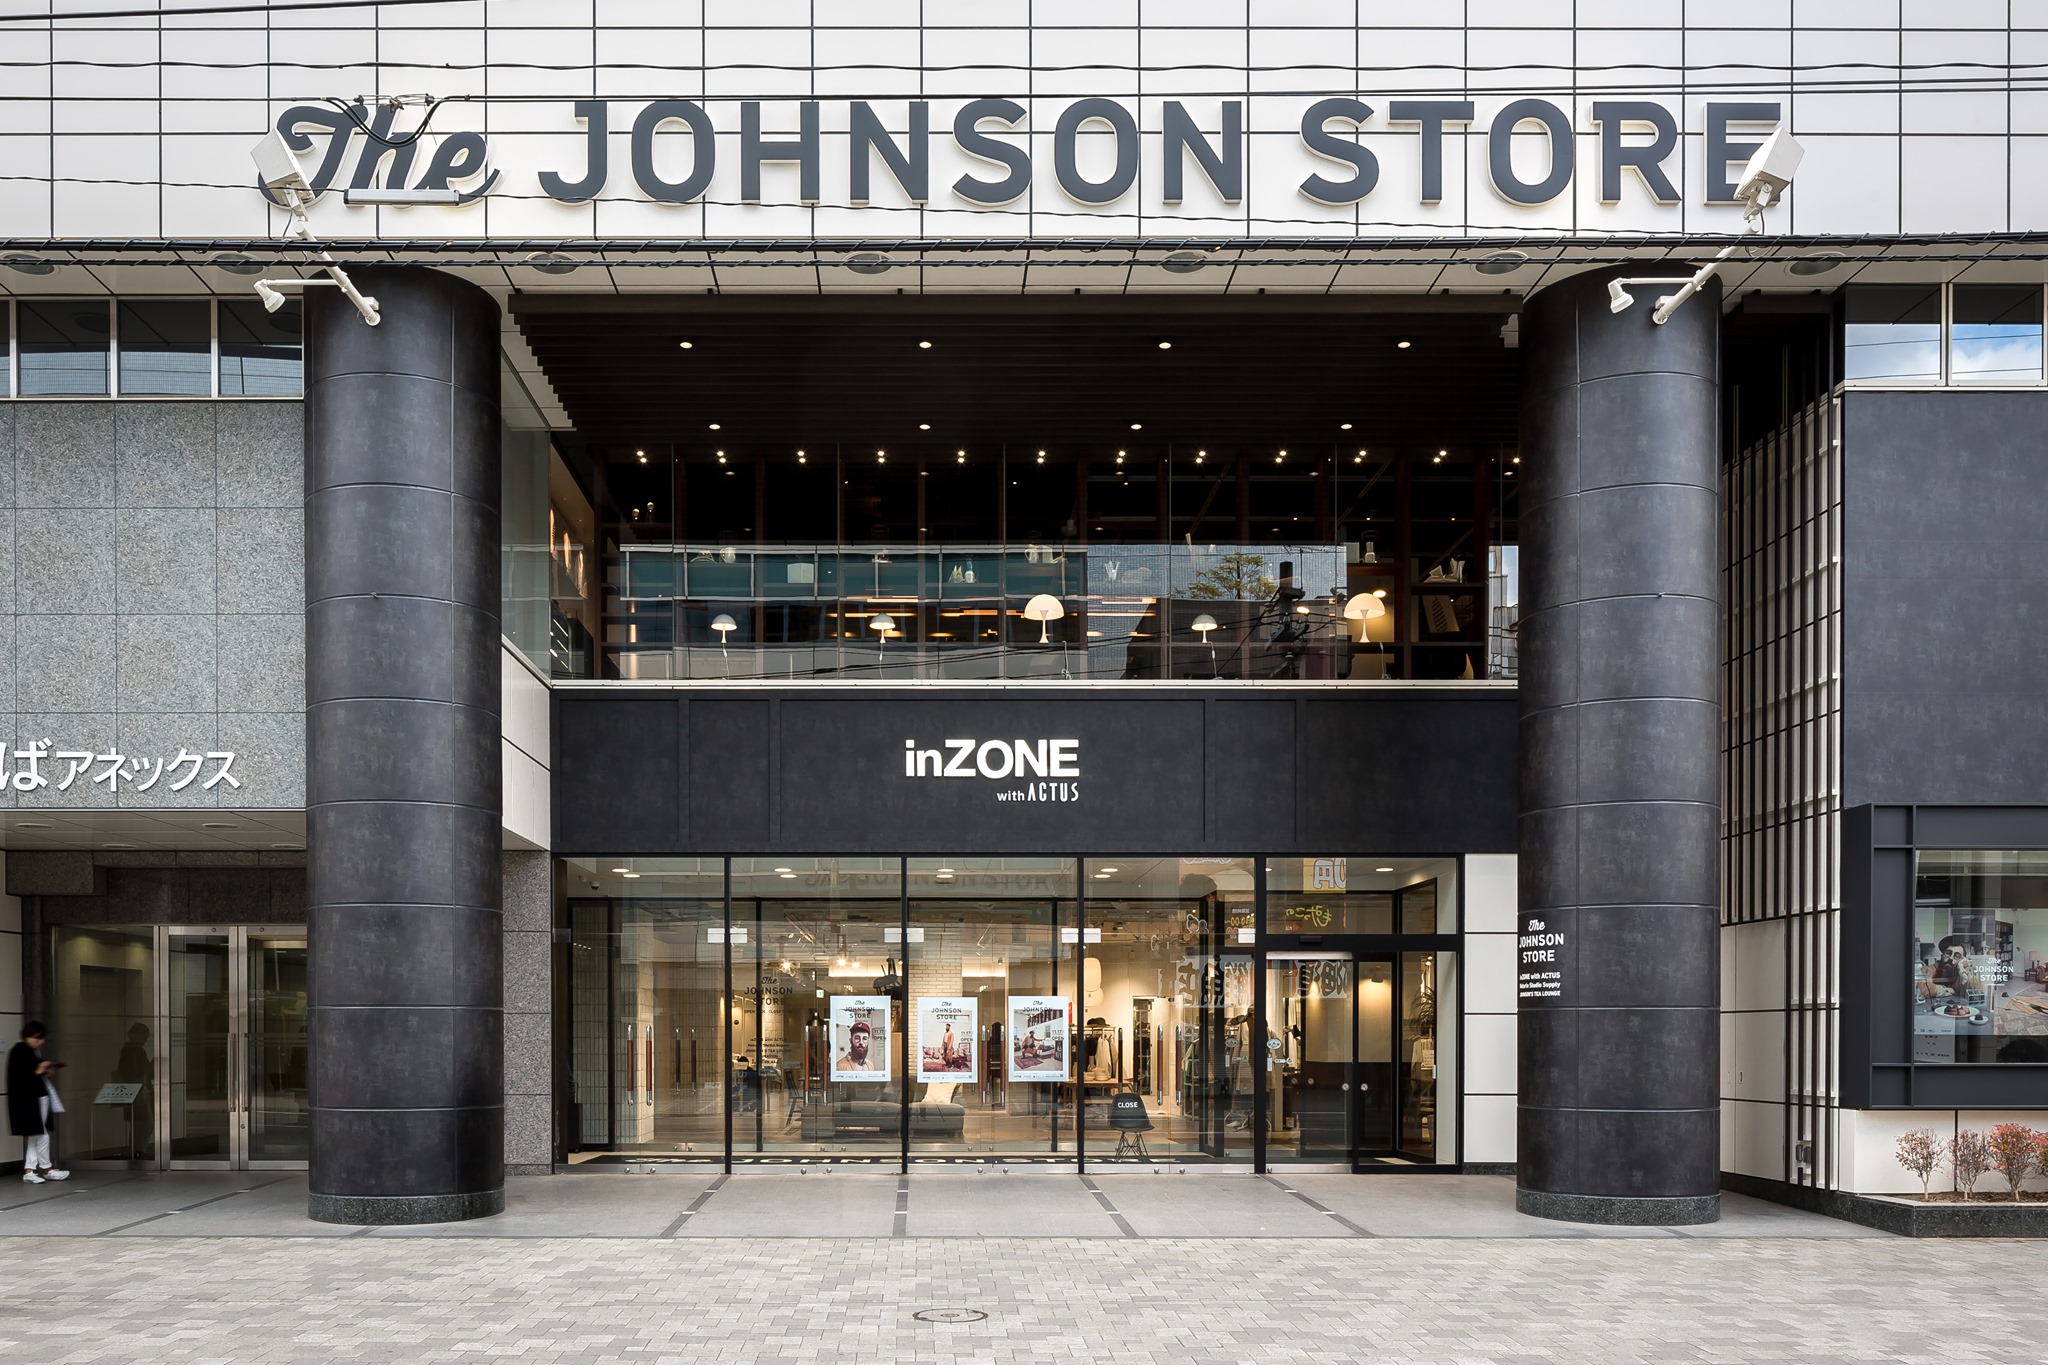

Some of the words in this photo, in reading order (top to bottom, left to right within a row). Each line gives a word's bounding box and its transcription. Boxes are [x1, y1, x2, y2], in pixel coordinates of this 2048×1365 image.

[257, 104, 501, 208] The
[538, 98, 1242, 206] JOHNSON
[1300, 98, 1782, 206] STORE
[0, 737, 241, 792] ばアネックス
[905, 739, 1080, 779] inZONE
[996, 790, 1025, 801] with
[1027, 782, 1080, 802] ACTUS
[1528, 919, 1546, 931] The
[1522, 950, 1555, 963] STORE
[1541, 971, 1561, 979] ACTUS
[1974, 965, 2014, 973] JOHNSON
[761, 976, 778, 985] The
[1981, 974, 2009, 982] STORE
